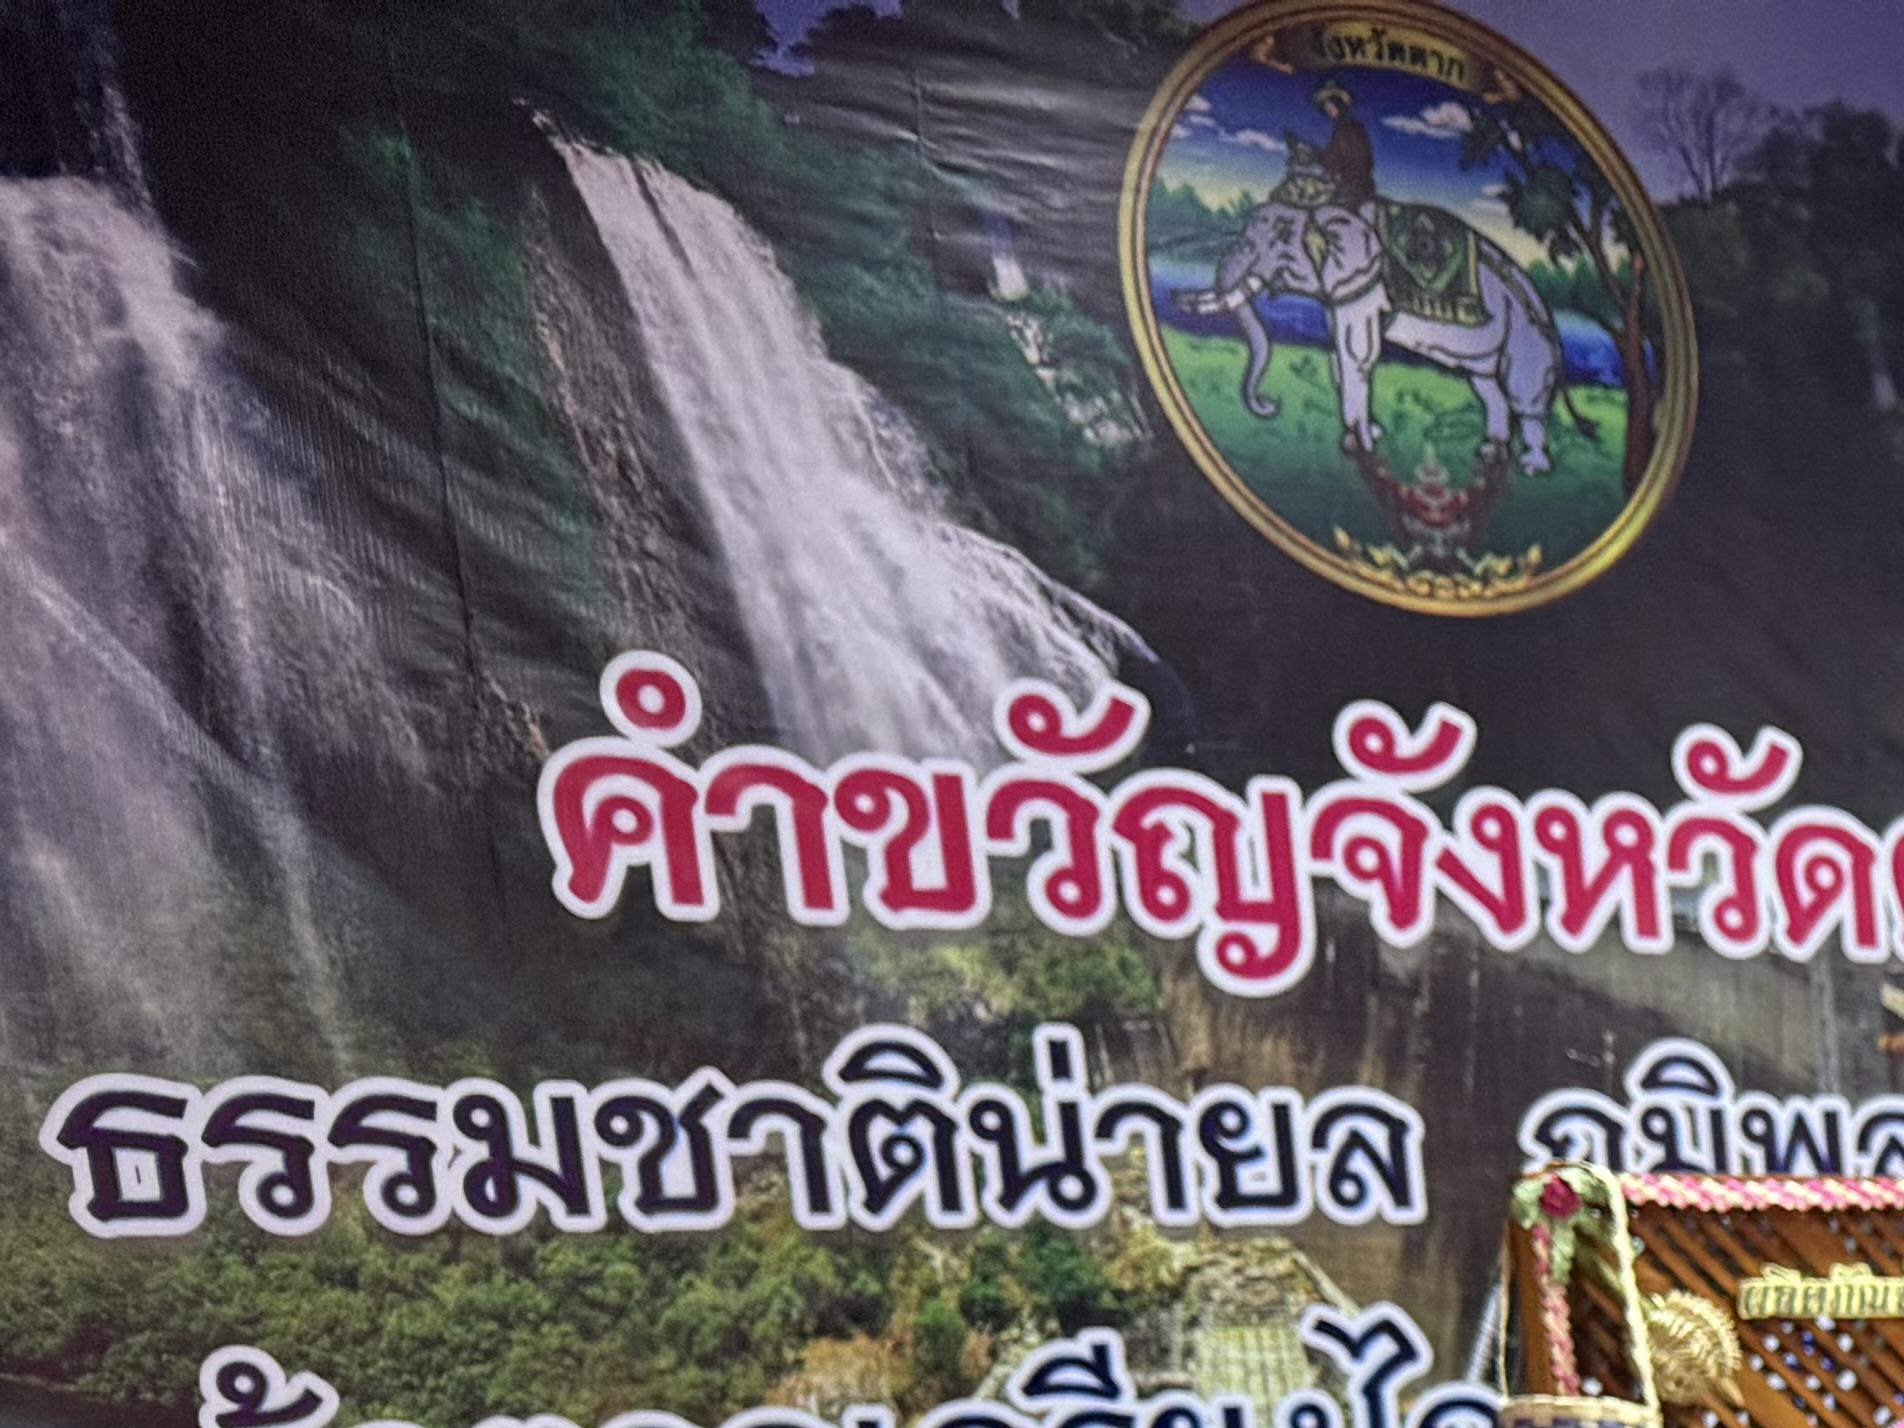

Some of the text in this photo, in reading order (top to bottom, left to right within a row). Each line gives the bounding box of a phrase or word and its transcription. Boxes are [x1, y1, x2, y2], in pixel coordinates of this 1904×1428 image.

[40, 1022, 1427, 1237] ธรรมชาติน่ายล
